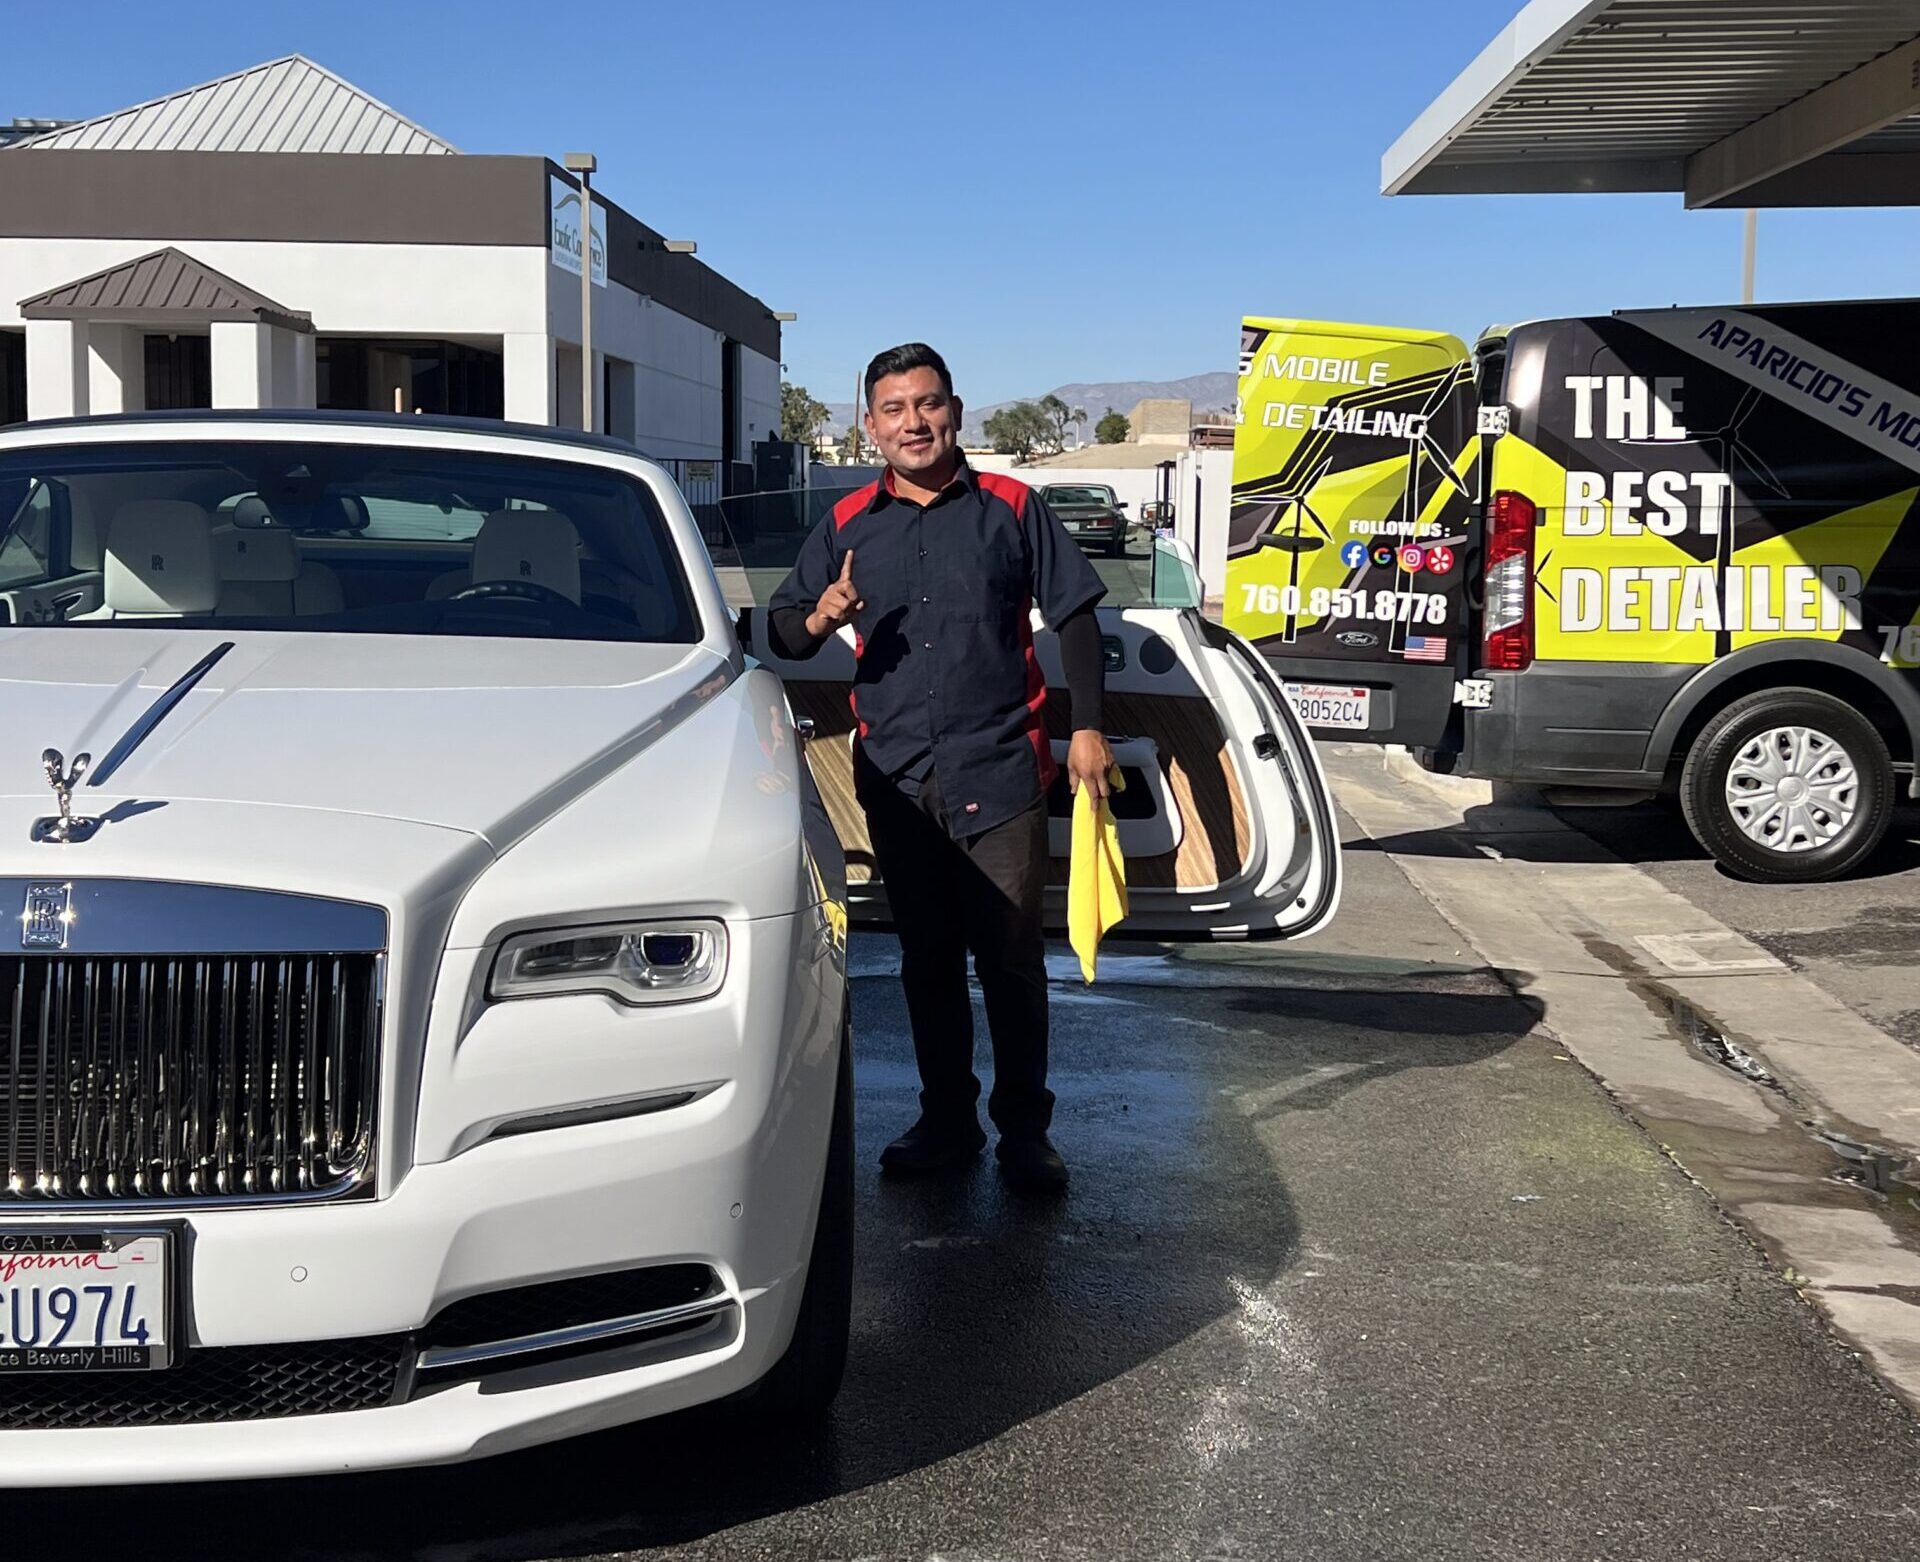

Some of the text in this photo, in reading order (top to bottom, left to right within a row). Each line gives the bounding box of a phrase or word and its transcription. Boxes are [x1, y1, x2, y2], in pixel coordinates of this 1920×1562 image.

[1264, 353, 1391, 387] MOBILE
[1697, 318, 1920, 453] APARICIO'S MO
[1262, 402, 1429, 440] DETAILING
[1565, 376, 1687, 440] THE
[1562, 471, 1731, 536] BEST
[1349, 519, 1416, 536] FOLLOW
[1241, 583, 1448, 625] 760.851.8778
[1560, 565, 1863, 632] DETAILER
[1292, 699, 1362, 722] 8052C4
[1300, 684, 1352, 699] California
[0, 1252, 118, 1282] fornia
[0, 1285, 150, 1347] U974
[27, 1349, 94, 1368] Beverly
[102, 1348, 141, 1363] Hills
